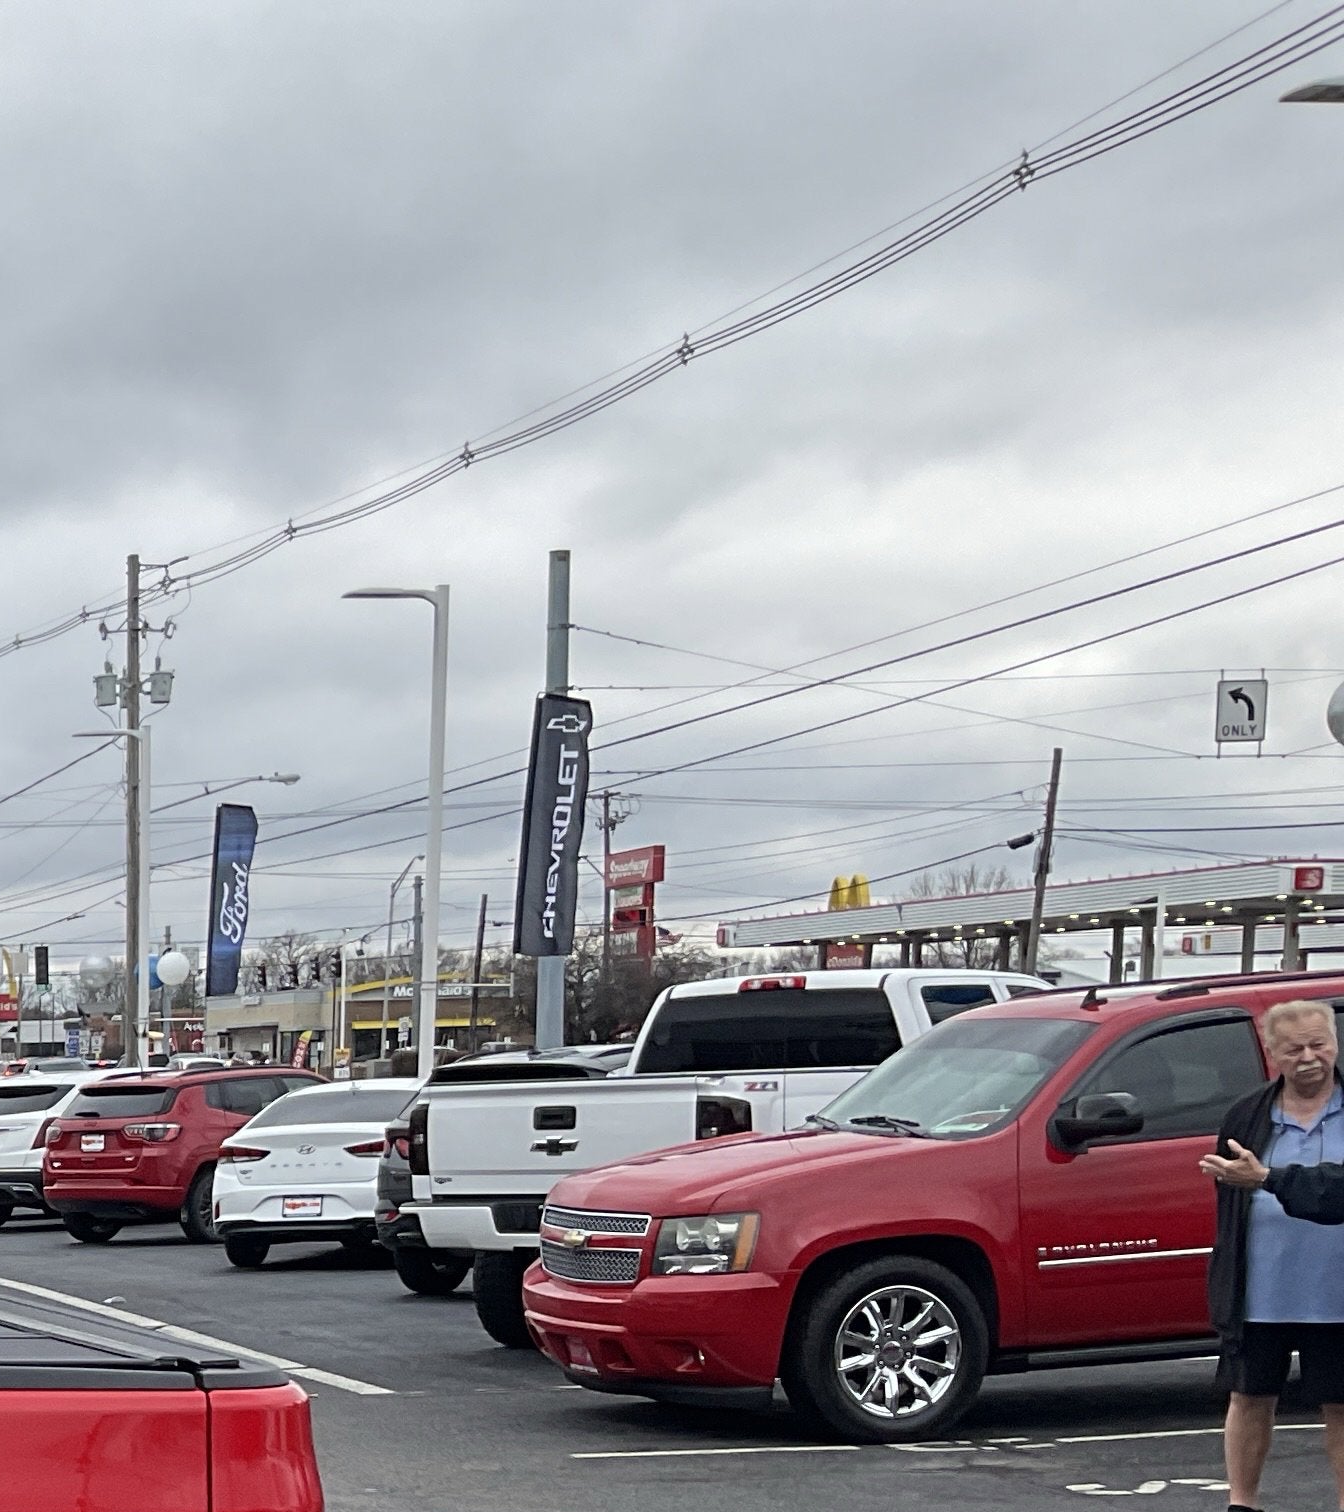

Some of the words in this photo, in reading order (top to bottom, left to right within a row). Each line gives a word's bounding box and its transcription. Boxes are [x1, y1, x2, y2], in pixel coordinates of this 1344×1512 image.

[1221, 725, 1257, 737] ONLY
[542, 743, 580, 939] CHEVROLET
[219, 862, 248, 945] Ford
[744, 1081, 778, 1092] Z71
